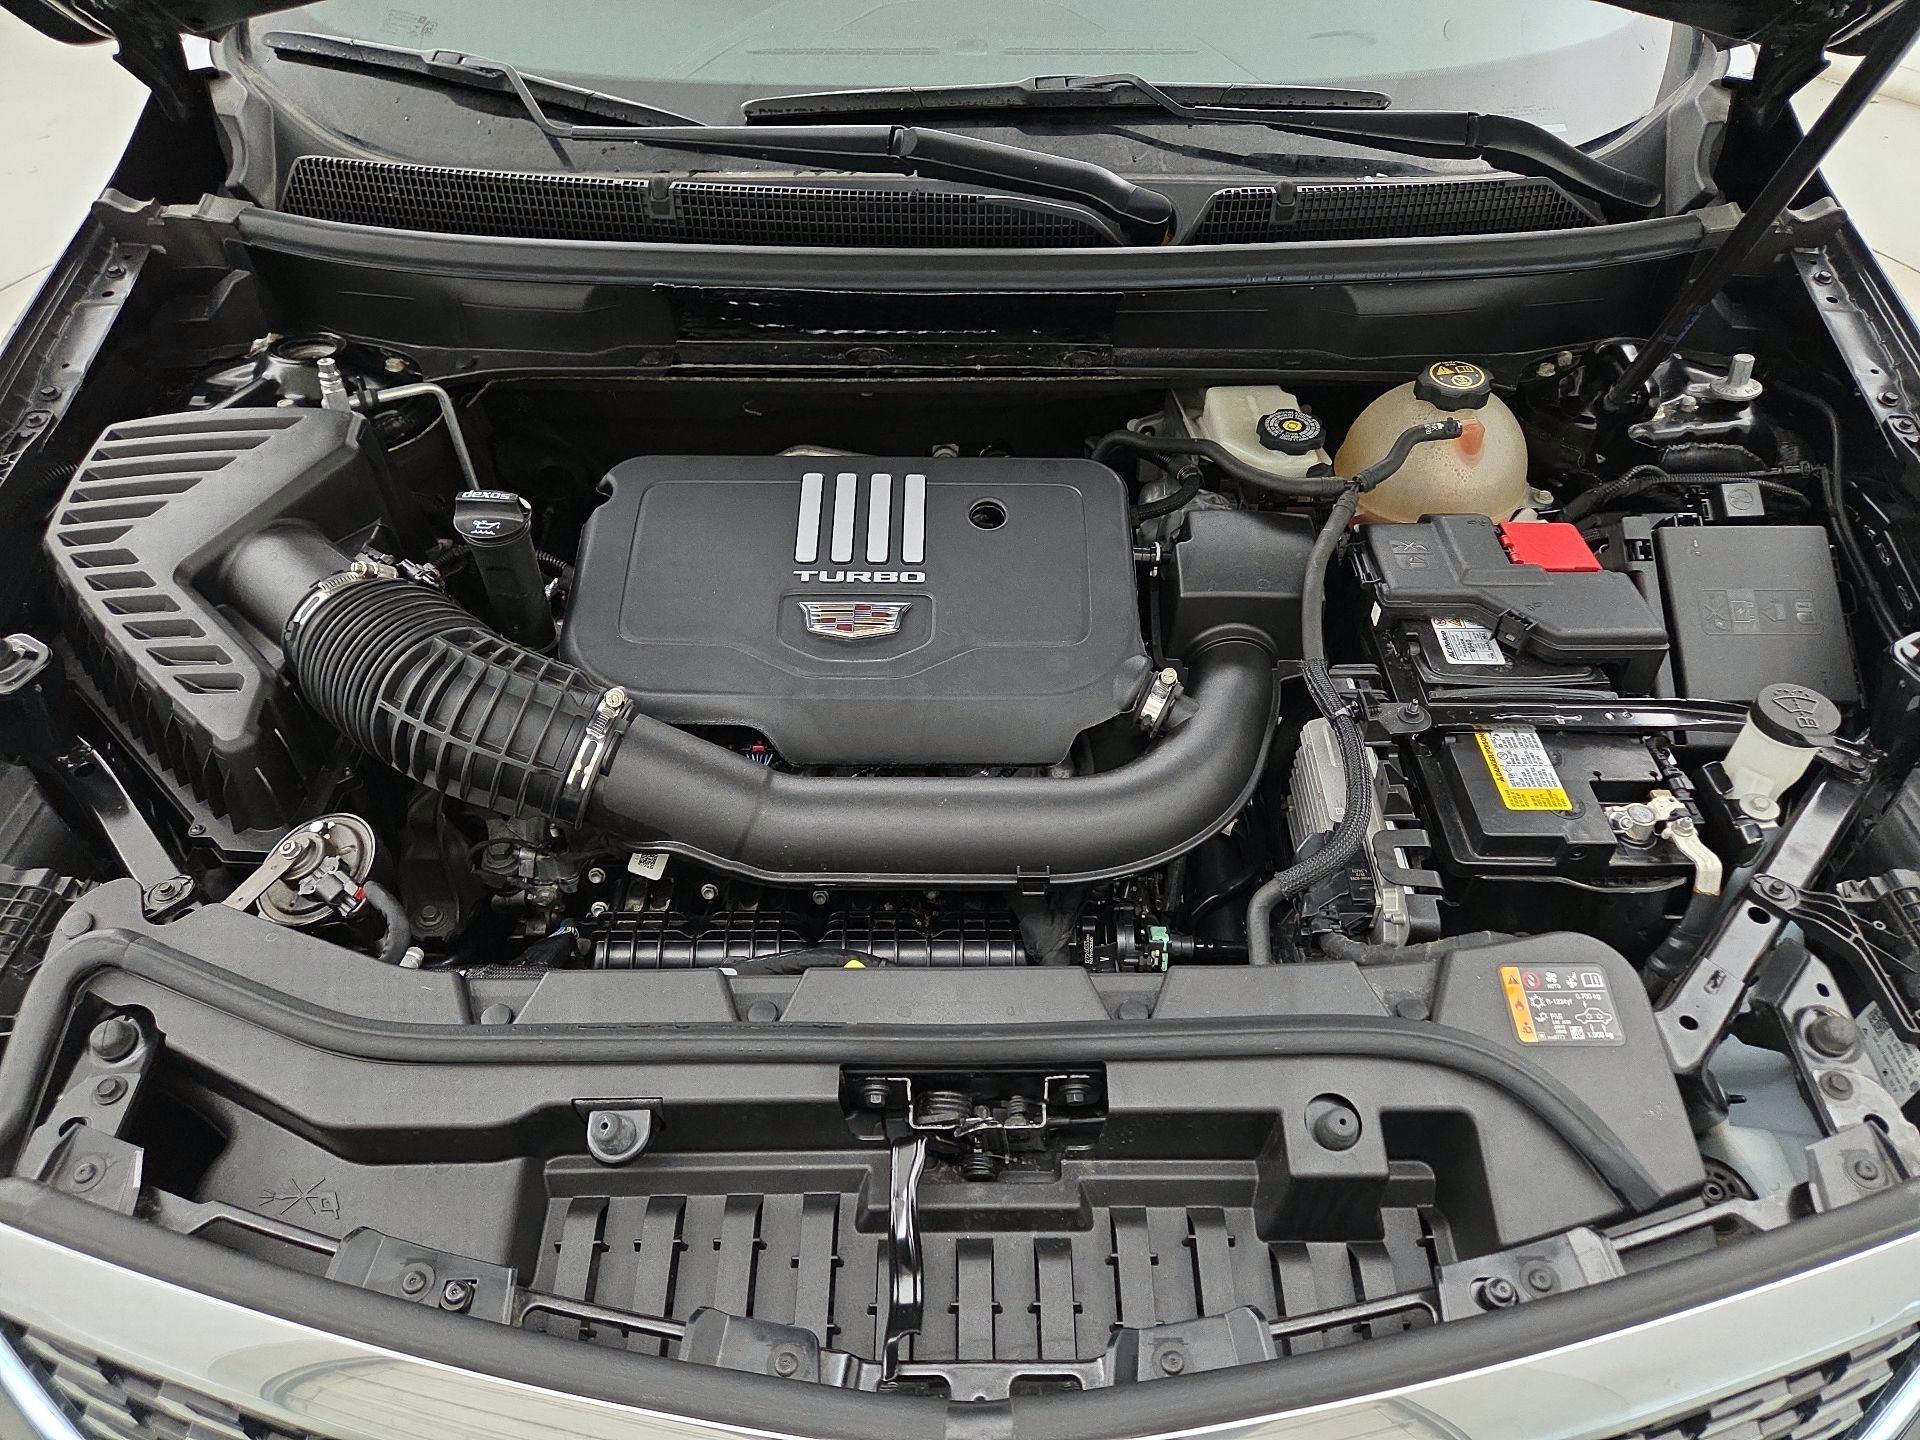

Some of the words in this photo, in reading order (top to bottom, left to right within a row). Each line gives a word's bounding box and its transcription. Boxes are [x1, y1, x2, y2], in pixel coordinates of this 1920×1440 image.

[462, 490, 510, 500] dexos
[793, 571, 926, 583] TURBO
[1546, 998, 1573, 1006] R-1234yf
